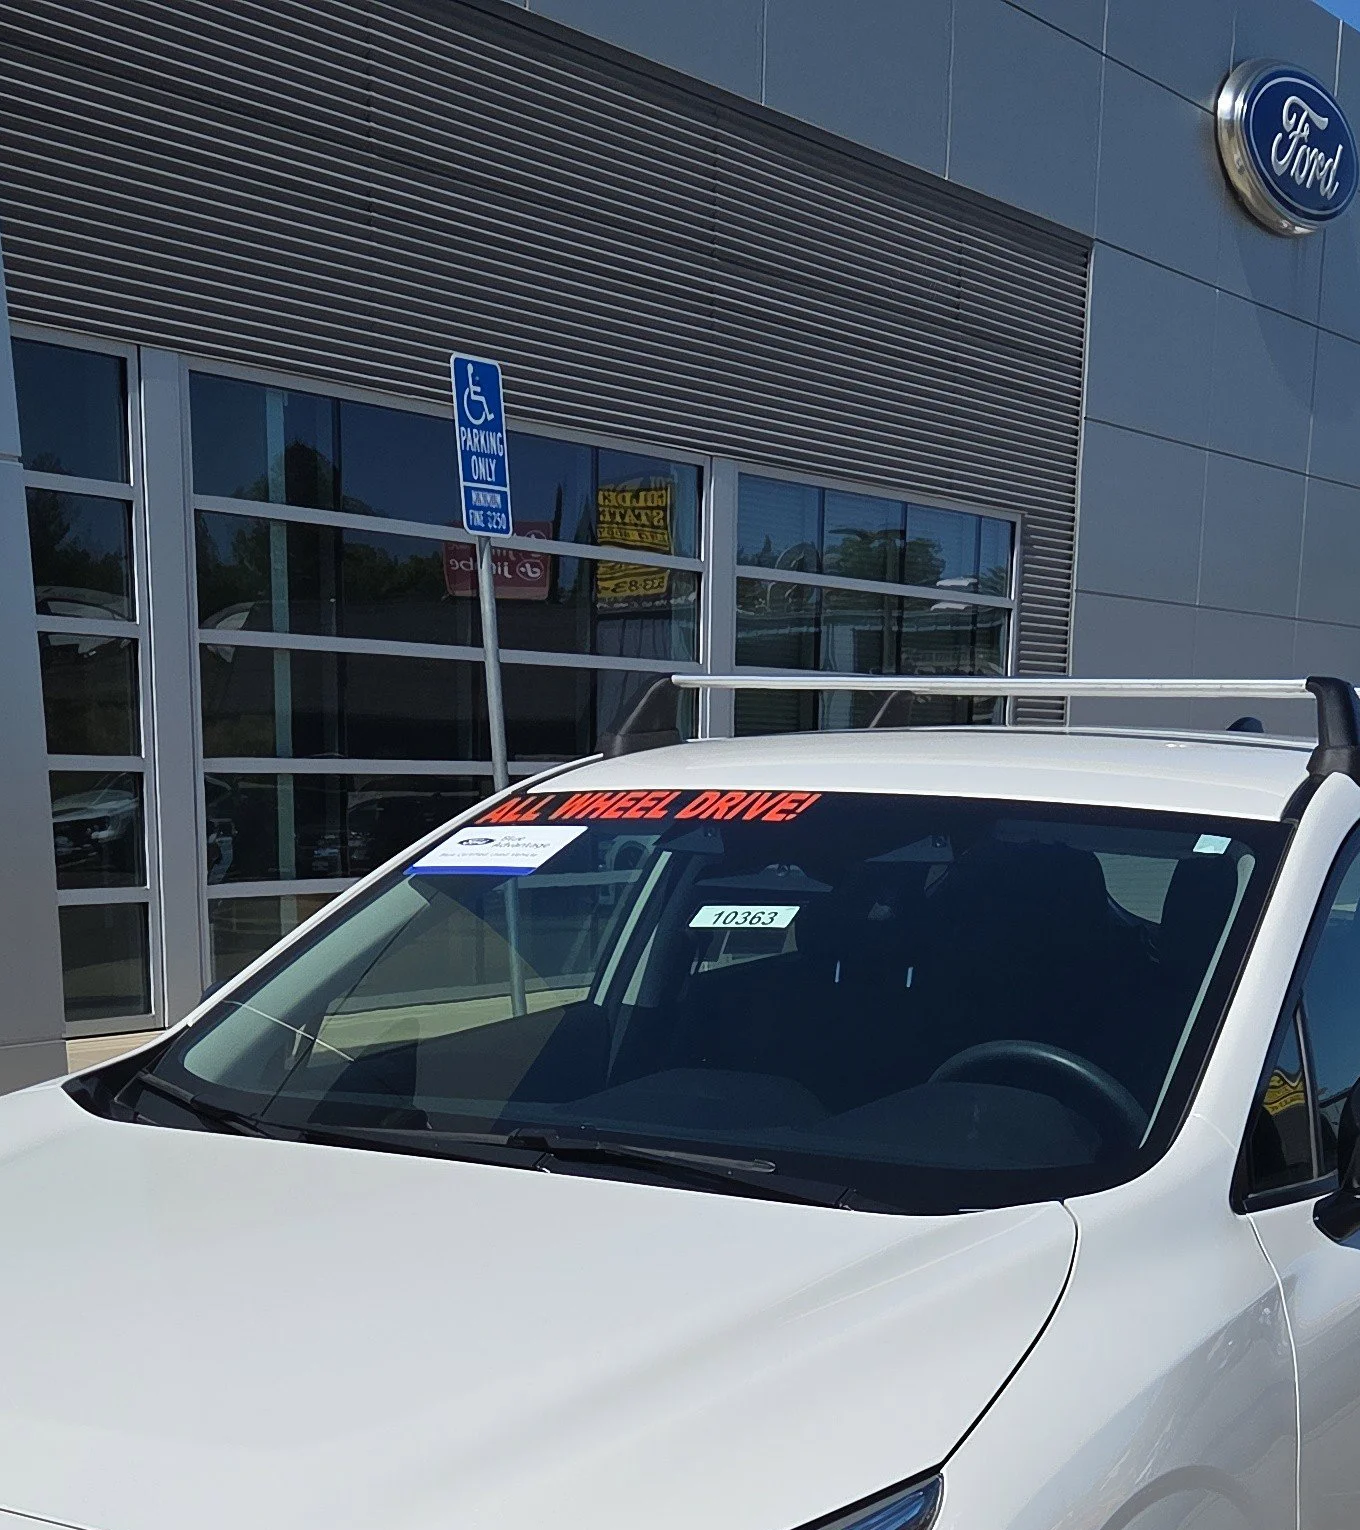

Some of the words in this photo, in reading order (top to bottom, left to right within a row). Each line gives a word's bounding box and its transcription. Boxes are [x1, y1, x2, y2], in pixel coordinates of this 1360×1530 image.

[1271, 95, 1343, 200] Ford
[460, 426, 504, 457] PARKING
[471, 455, 497, 482] ONLY
[469, 508, 485, 528] FINE
[474, 795, 556, 824] ALL
[548, 790, 681, 821] WHEEL
[674, 791, 823, 822] DRIVE!
[712, 911, 779, 926] 10363
